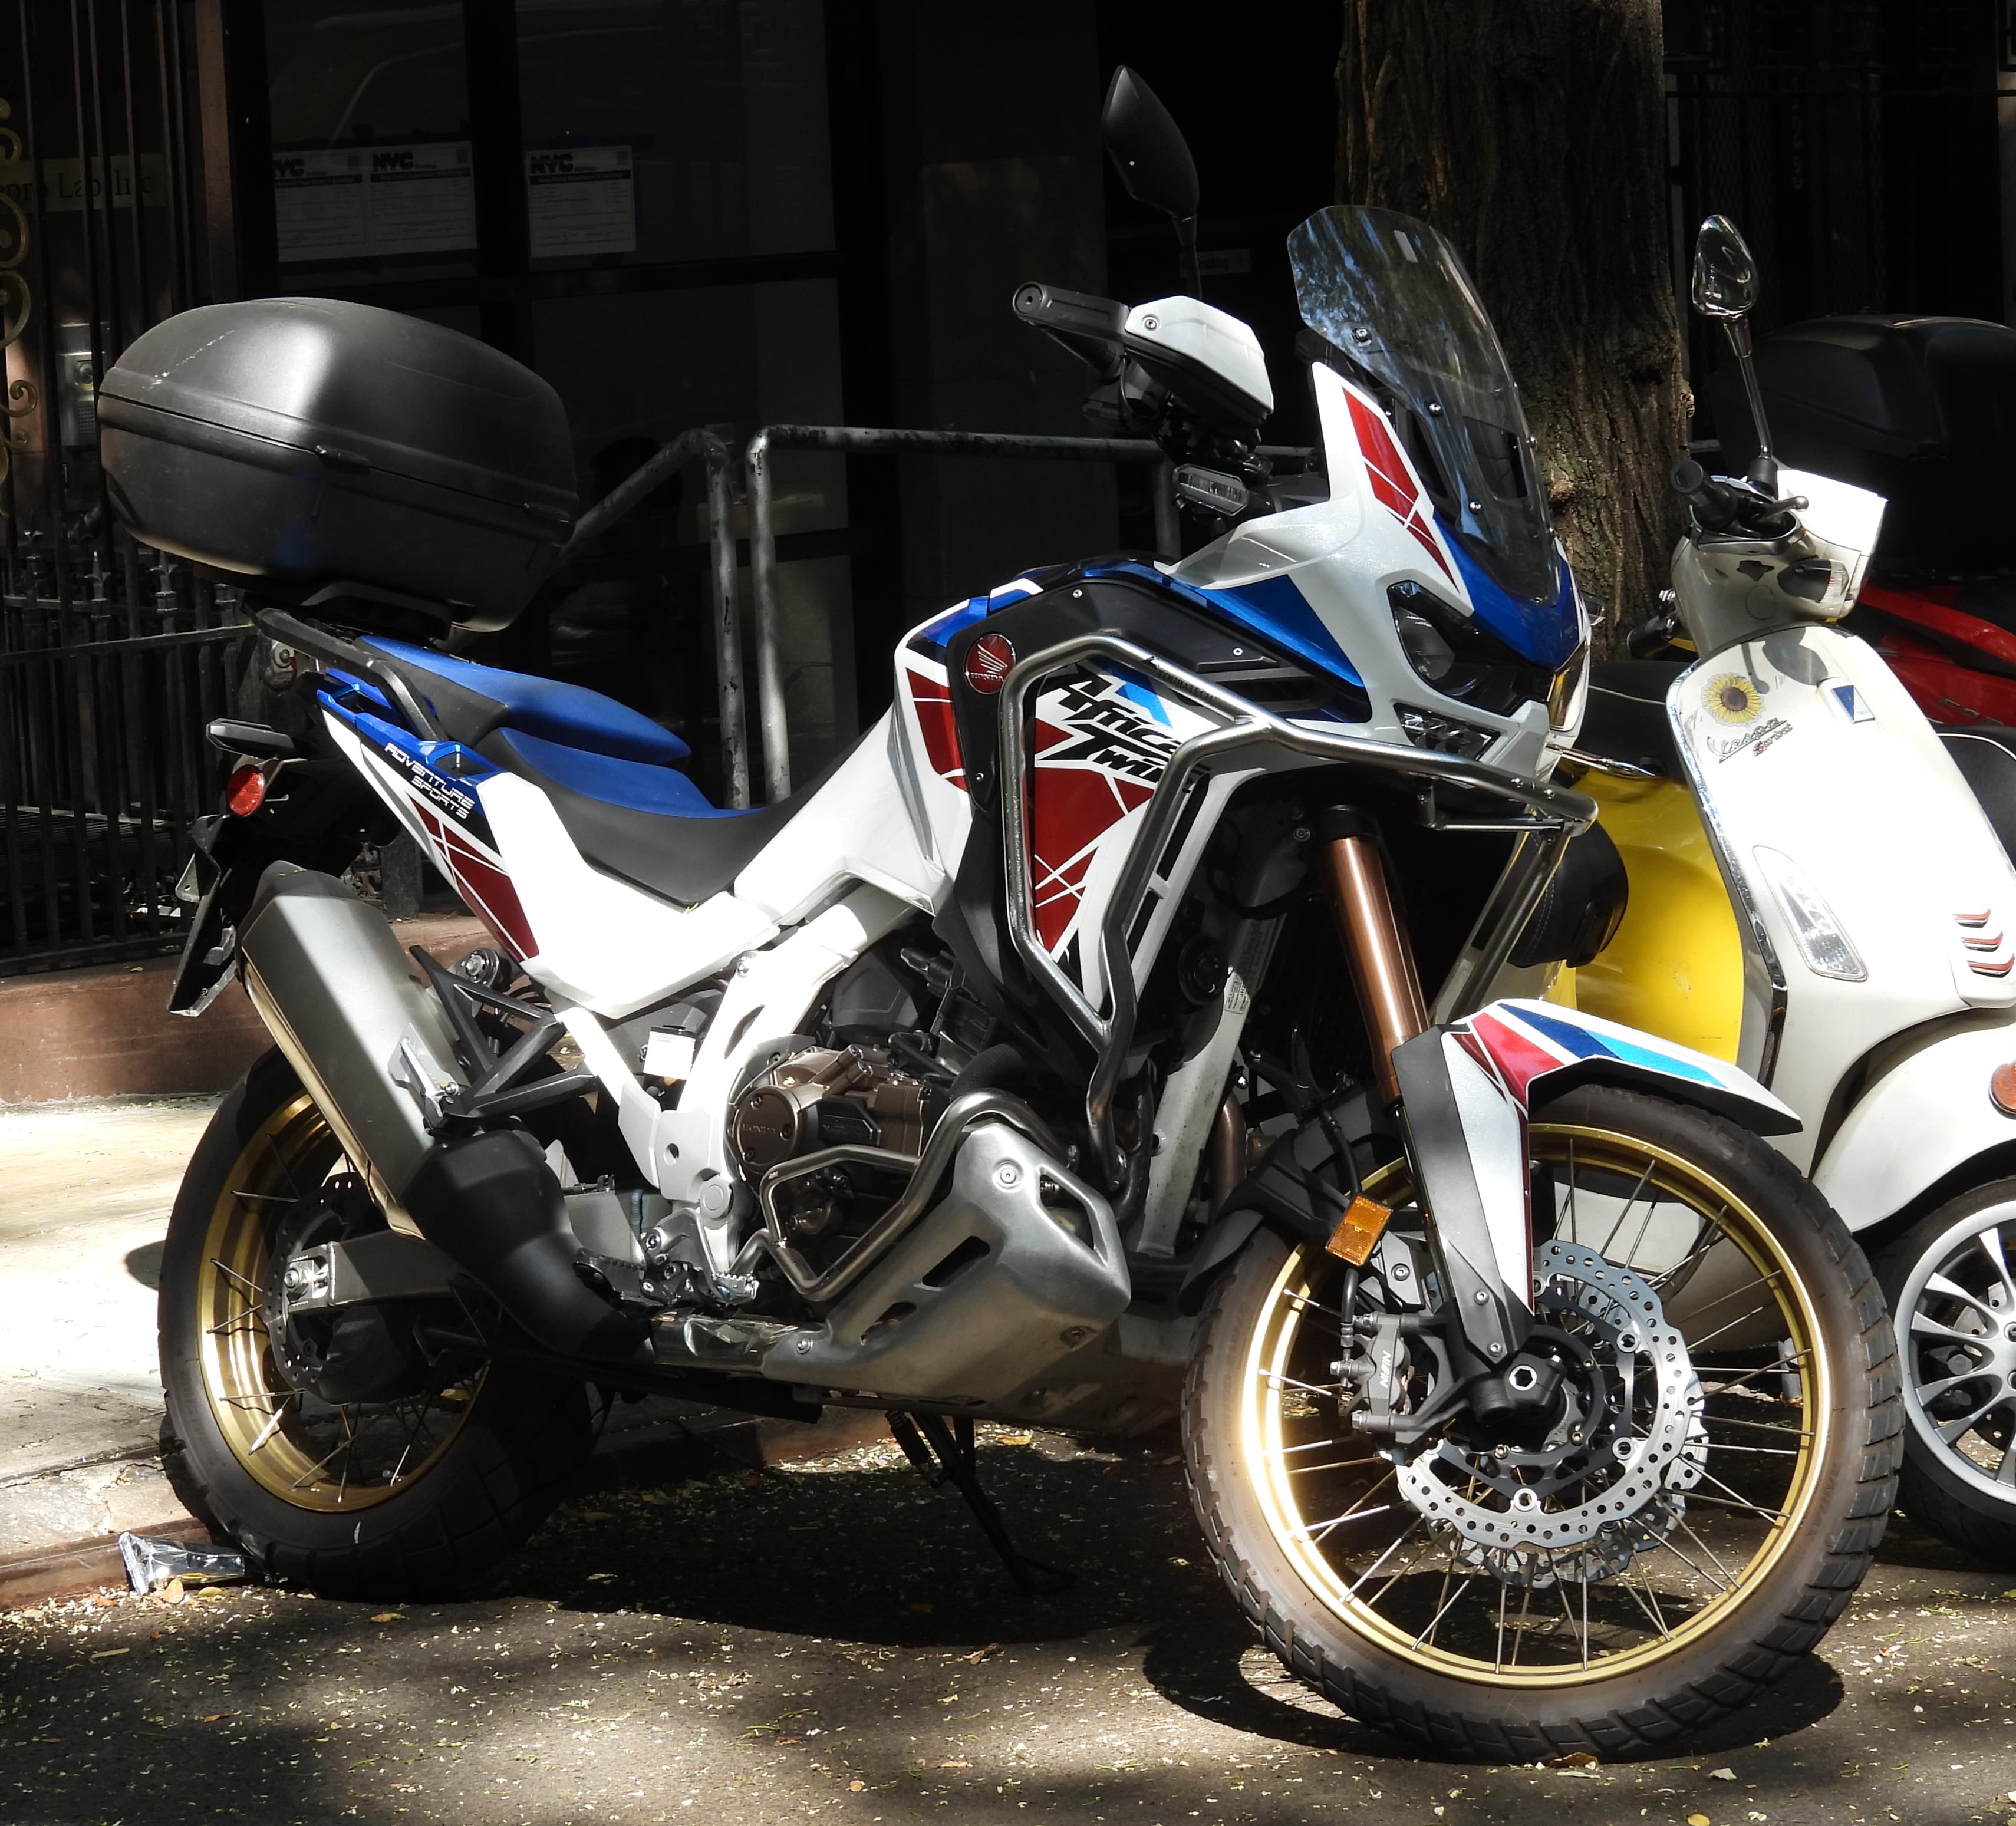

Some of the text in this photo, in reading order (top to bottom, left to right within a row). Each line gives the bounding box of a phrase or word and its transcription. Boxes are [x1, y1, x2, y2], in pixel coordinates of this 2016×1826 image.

[373, 152, 414, 172] NYC
[530, 153, 574, 174] NYC
[970, 672, 1005, 682] HONDA
[1158, 670, 1214, 703] TOURATECH
[1707, 717, 1785, 762] Vespa
[1752, 723, 1793, 757] Sprint
[384, 742, 475, 810] ADVENTURE
[411, 775, 470, 819] SPORTS
[1379, 1349, 1392, 1389] NISSIN
